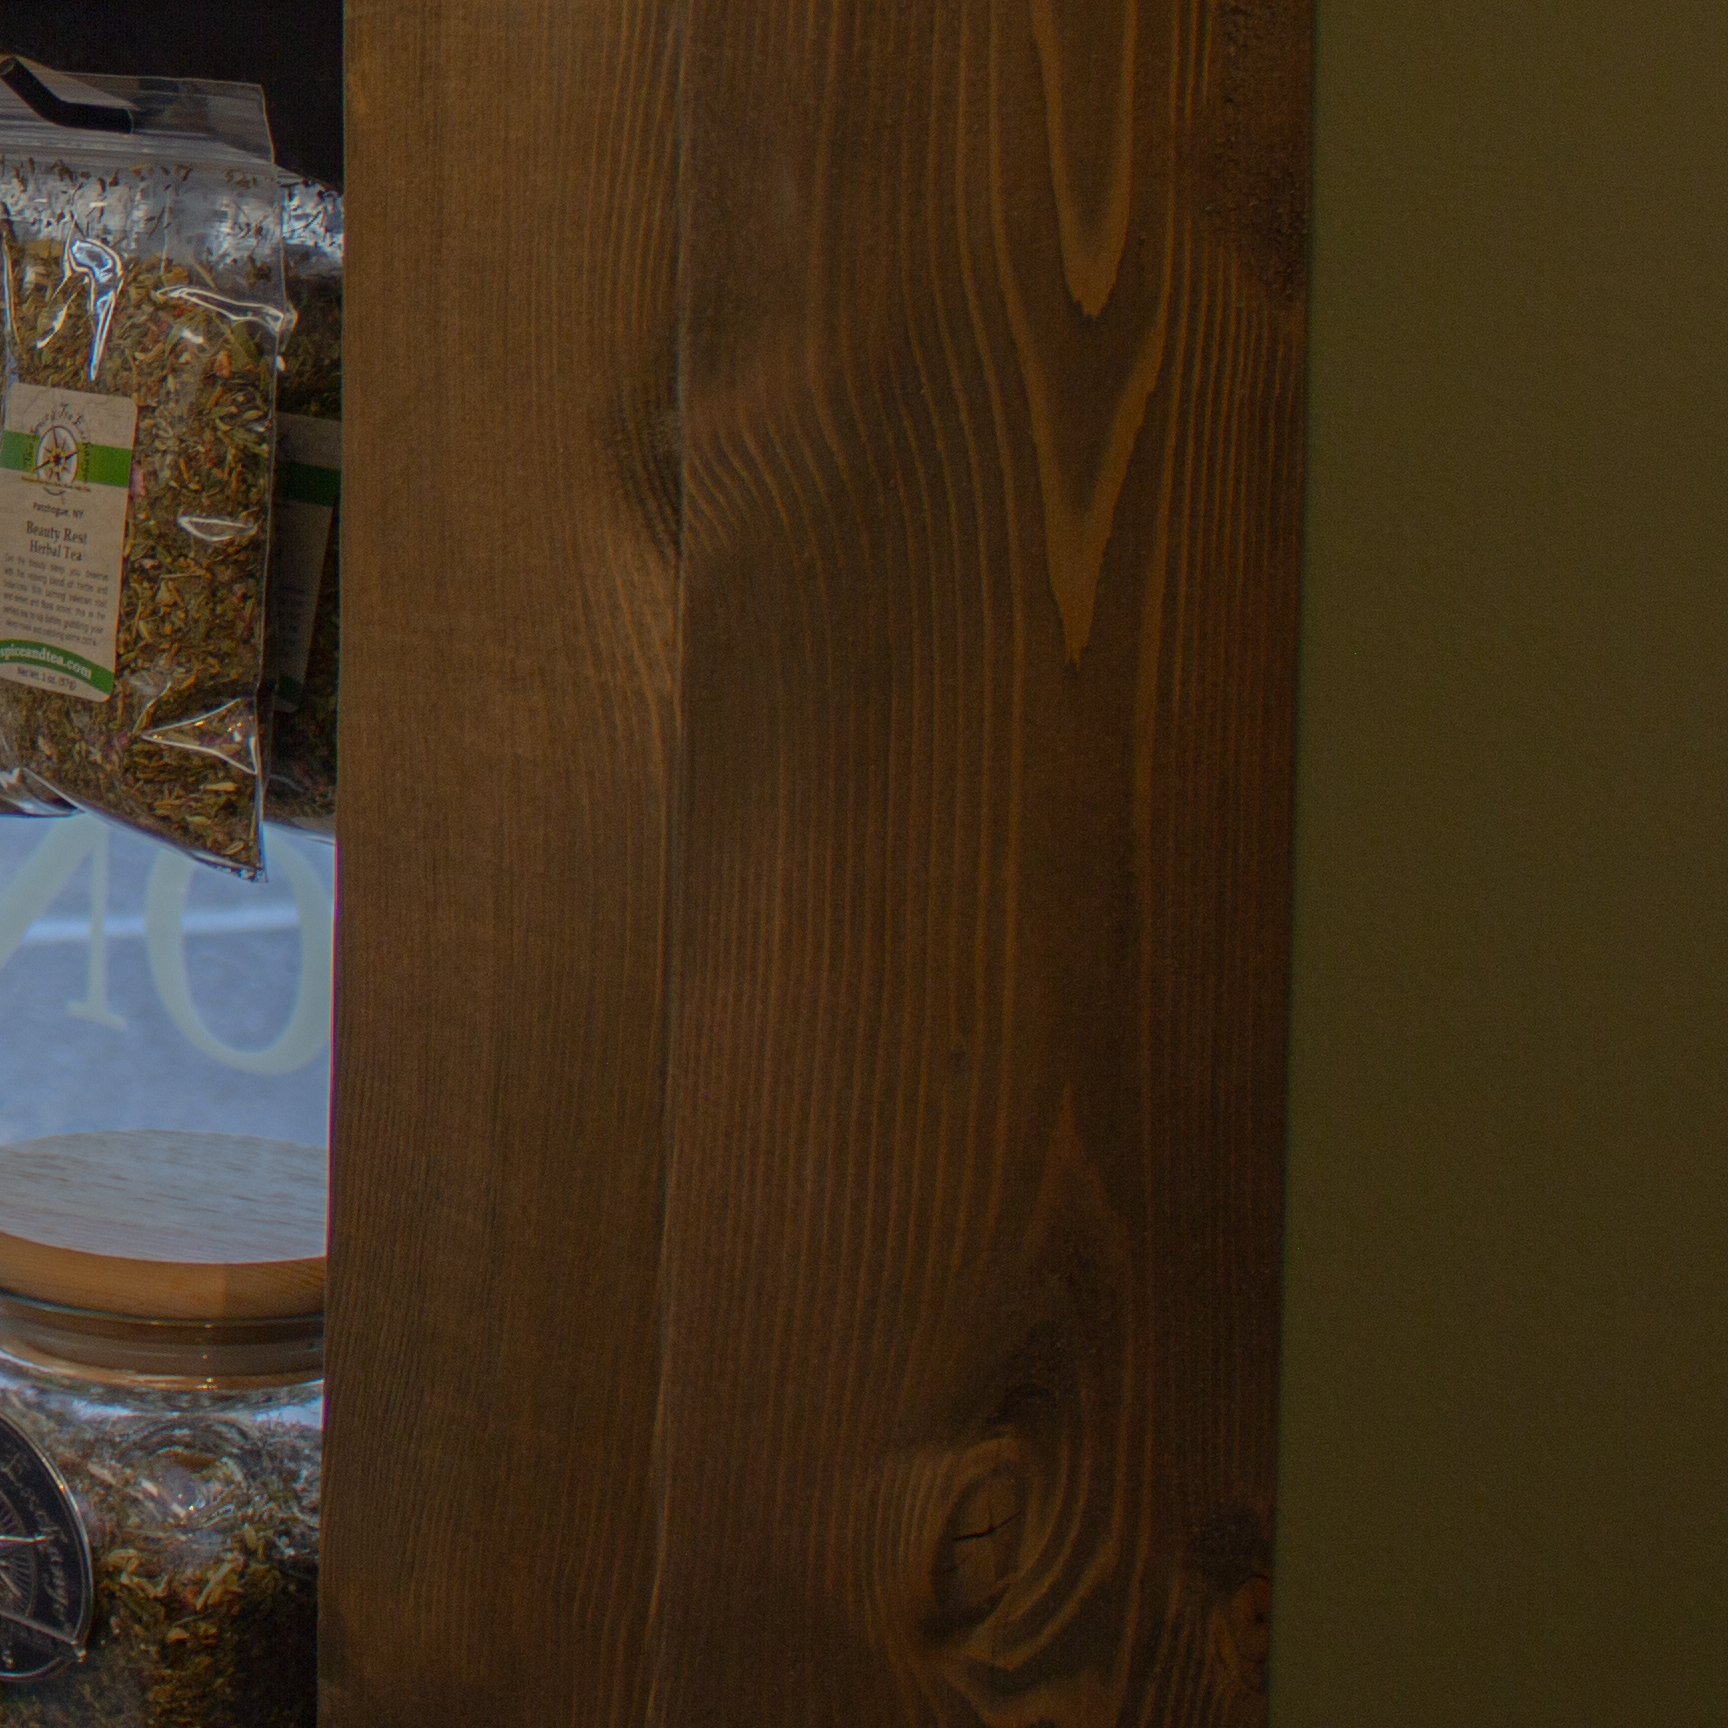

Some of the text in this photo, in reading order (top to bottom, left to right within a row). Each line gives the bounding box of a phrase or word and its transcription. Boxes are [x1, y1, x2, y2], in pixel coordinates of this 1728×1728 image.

[26, 520, 87, 545] Beauty Rest
[30, 540, 82, 562] Herbal Tea
[0, 643, 92, 680] spiceandtea.com
